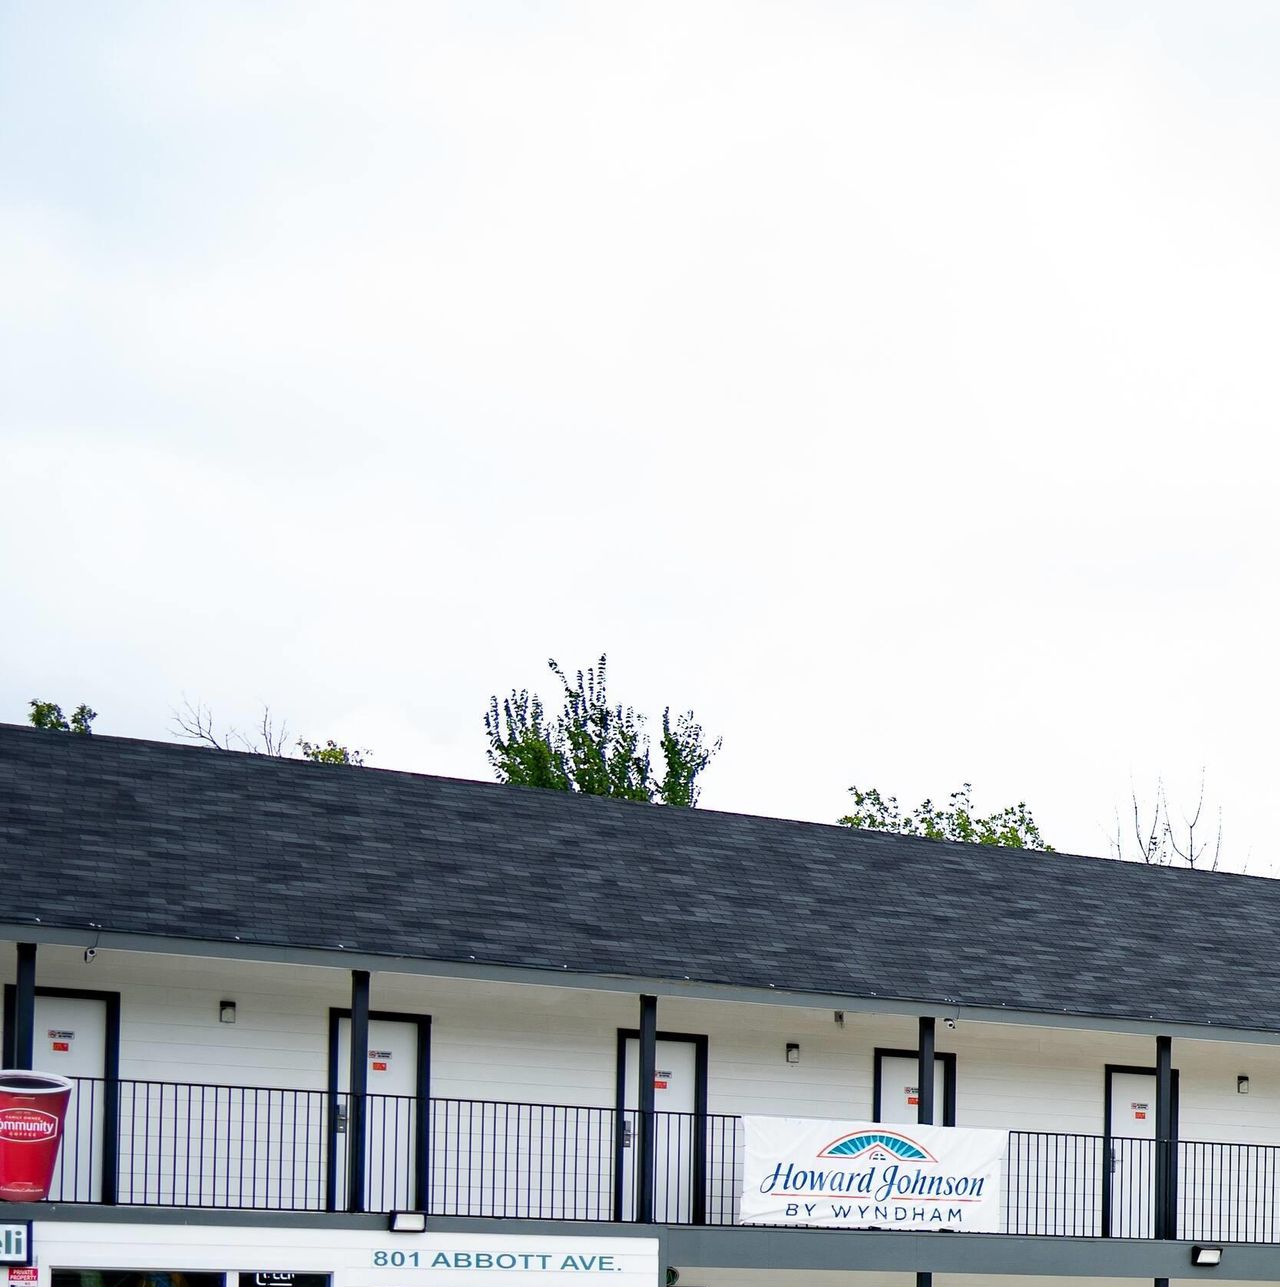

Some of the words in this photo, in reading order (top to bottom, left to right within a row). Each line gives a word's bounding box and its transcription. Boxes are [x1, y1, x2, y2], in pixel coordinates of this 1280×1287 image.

[0, 1119, 54, 1135] ommunity
[760, 1163, 876, 1194] Howard
[874, 1165, 985, 1202] Johnson
[785, 1203, 816, 1217] BY
[832, 1204, 963, 1222] WYNDHAM
[373, 1251, 420, 1267] 801
[431, 1252, 553, 1270] ABBOTT
[560, 1255, 622, 1271] AVE.
